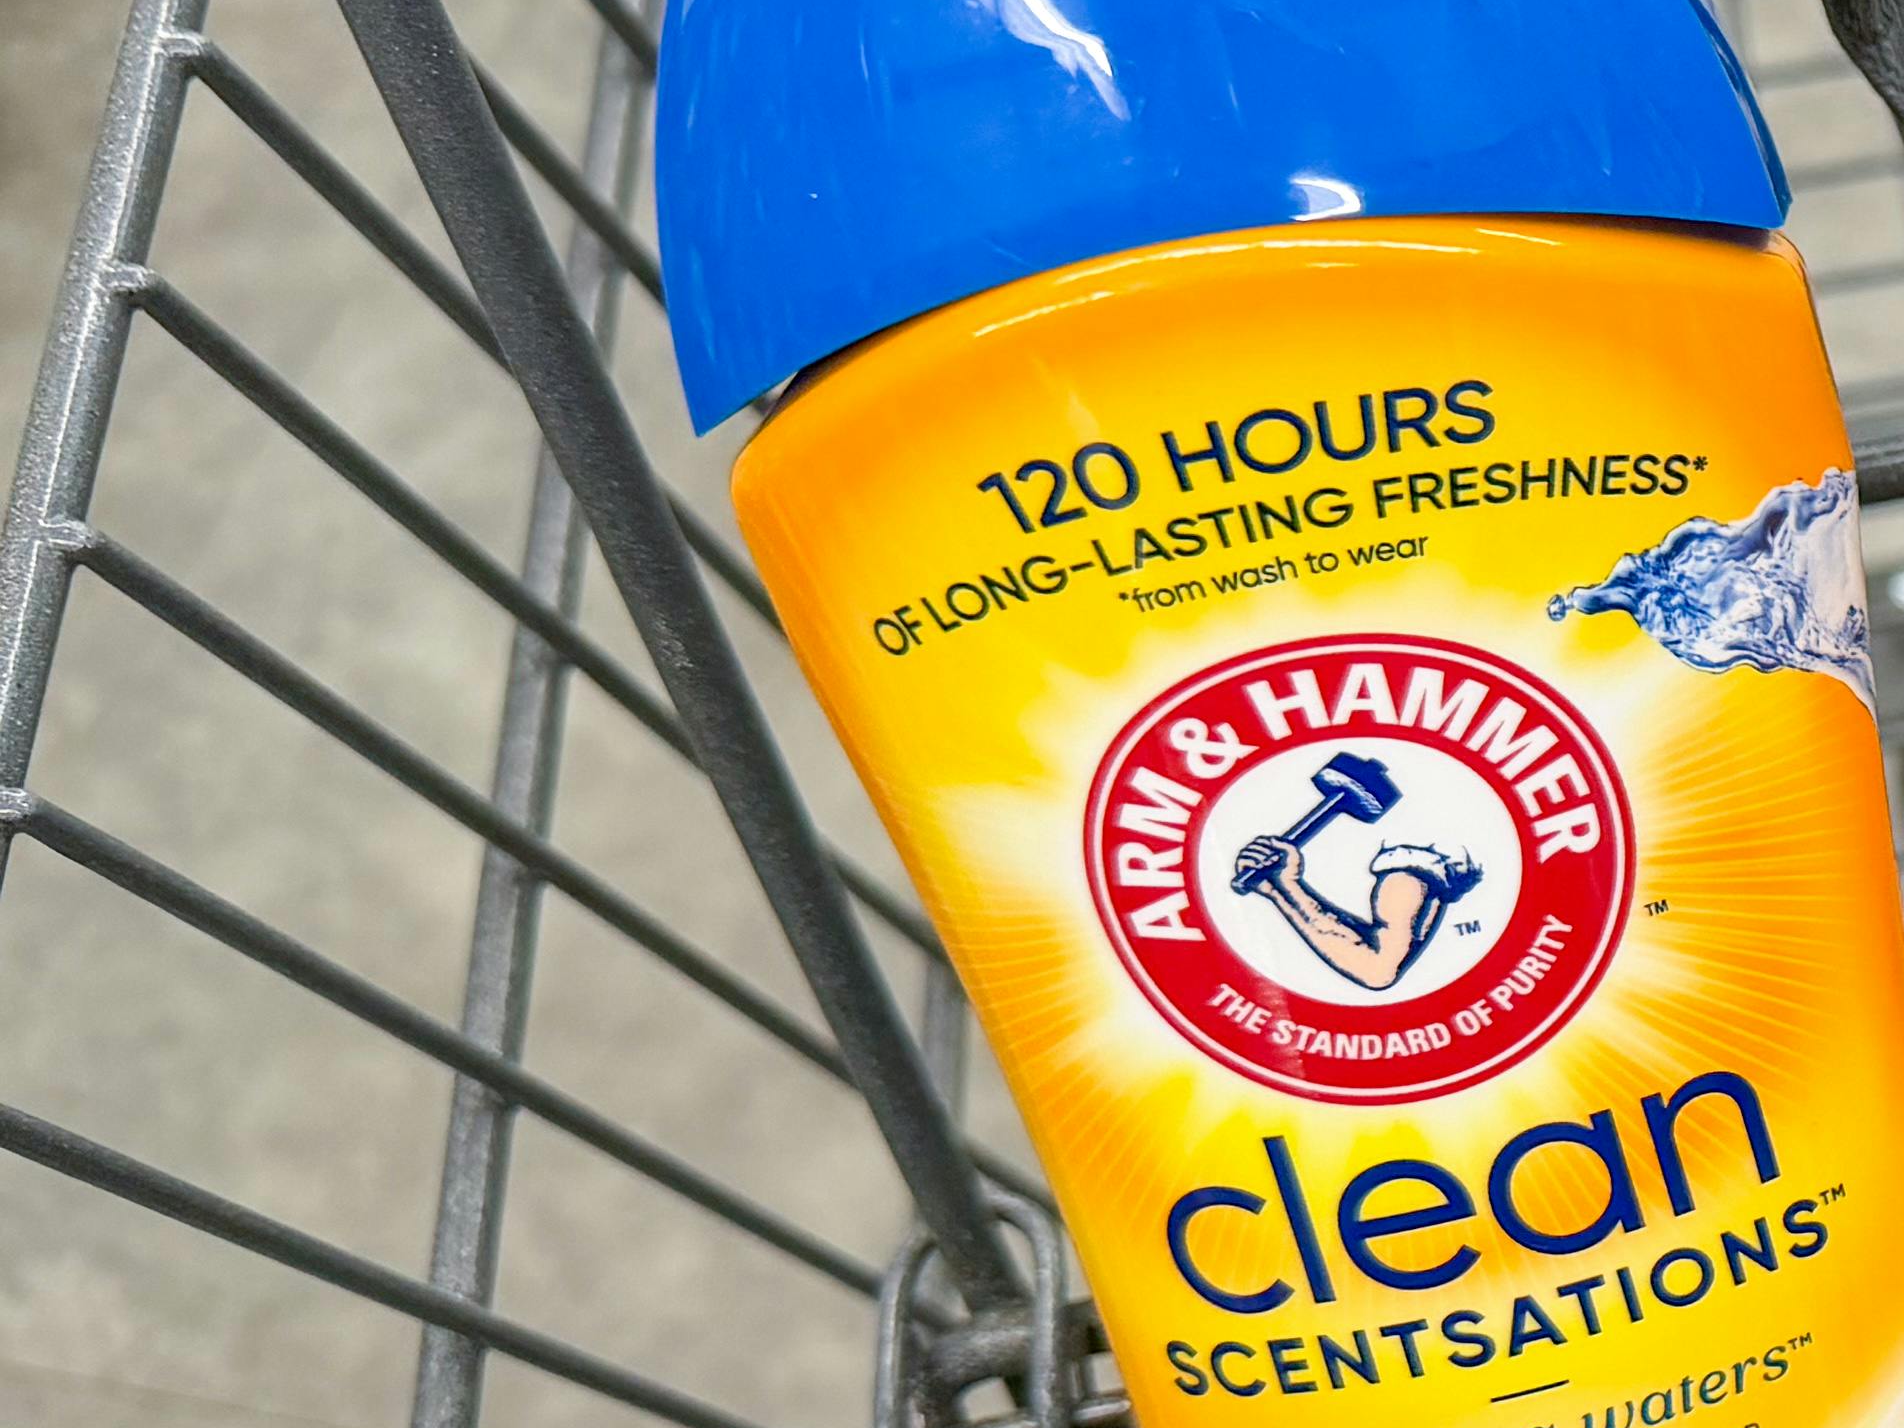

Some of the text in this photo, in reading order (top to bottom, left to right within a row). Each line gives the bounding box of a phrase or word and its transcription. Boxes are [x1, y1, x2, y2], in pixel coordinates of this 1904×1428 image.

[976, 377, 1496, 534] 120 HOURS
[873, 609, 929, 658] OF
[927, 484, 1353, 633] LONG-LASTING
[1212, 559, 1299, 603] wash
[1304, 549, 1342, 579] to
[1346, 533, 1428, 572] wear
[1111, 661, 1603, 943] ARM & HAMMER
[1208, 913, 1574, 1061] THE STANDARD OF PURITY
[1166, 1070, 1782, 1315] clean
